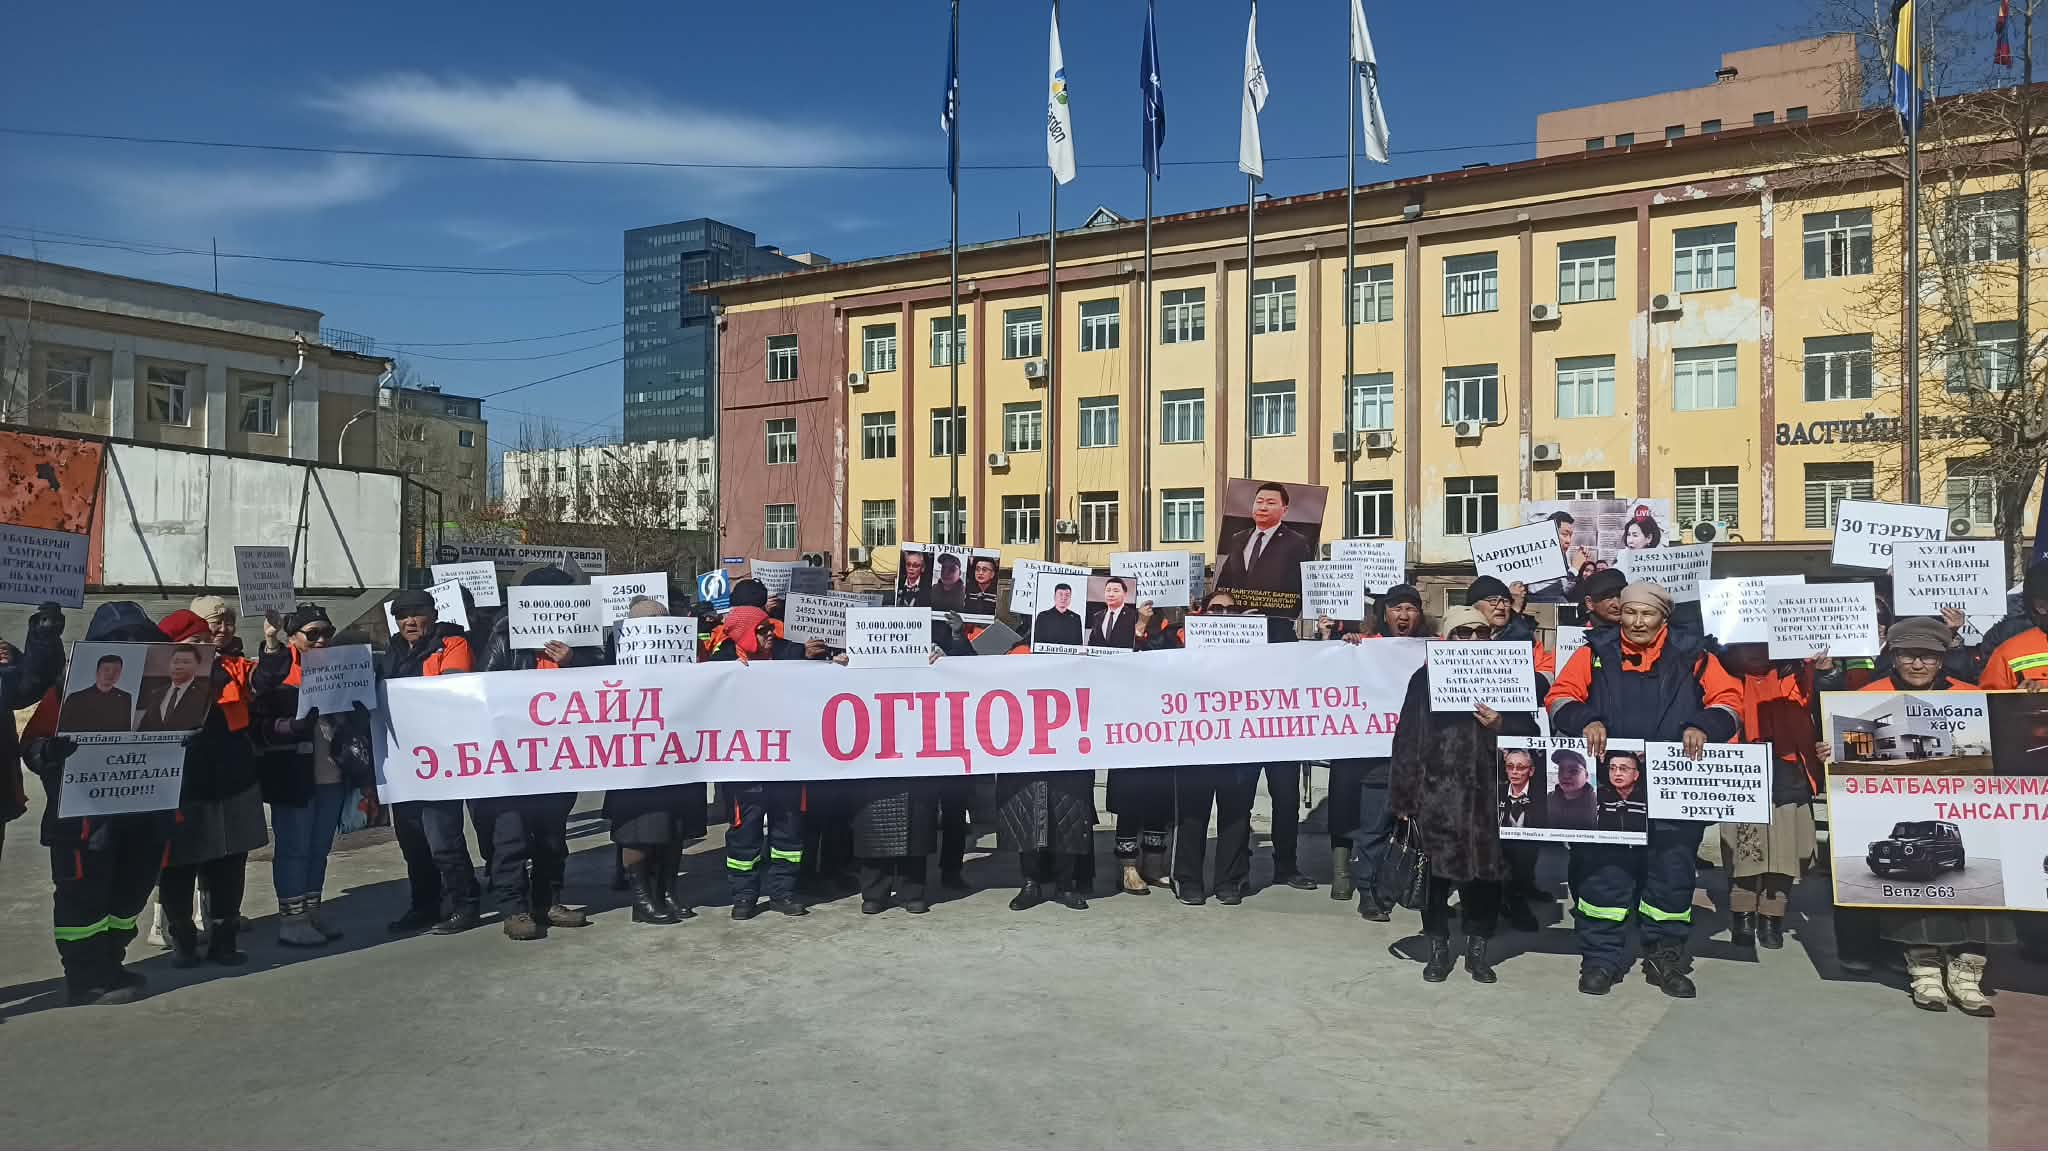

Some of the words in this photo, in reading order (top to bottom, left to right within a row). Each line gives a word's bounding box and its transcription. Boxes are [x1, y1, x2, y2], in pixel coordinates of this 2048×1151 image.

[1841, 518, 1863, 534] 30
[1866, 522, 1943, 541] ТЭРБУМ
[1476, 538, 1559, 563] ХАРИУЦЛАГА
[1868, 542, 1893, 556] ТӨ
[1496, 556, 1544, 573] ТООЦ!!!
[1905, 558, 1990, 569] ЭНХТАЙВАНЫ
[1917, 573, 1979, 583] БАТБАЯРТ
[612, 584, 646, 595] 24500
[518, 600, 591, 609] 30.000.000.000
[512, 626, 554, 635] ХААНА
[557, 624, 600, 634] БАЙНА
[666, 624, 693, 635] БУС
[855, 621, 922, 631] 30.000.000.000
[848, 645, 888, 655] ХААНА
[890, 644, 929, 654] БАЙНА
[1433, 648, 1469, 656] ХУЛГАЙ
[1471, 648, 1508, 656] ХИЙСЭН
[1509, 648, 1527, 656] БОЛ
[528, 679, 666, 731] САЙД
[1160, 691, 1190, 716] 30
[1194, 687, 1301, 714] ТЭРБУМ
[1306, 685, 1368, 711] ТӨЛ,
[1905, 704, 1983, 718] Шамбала
[820, 687, 1092, 774] ОГЦОР!
[1104, 717, 1233, 747] НООГДОЛ
[1239, 714, 1359, 740] АШИГАА
[1365, 711, 1400, 735] АВ
[1930, 720, 1966, 733] хаус
[1527, 737, 1546, 749] 3-н
[1550, 737, 1587, 749] УРВА
[106, 752, 147, 766] САЙД
[411, 729, 792, 781] Э.БАТАМГАЛАН
[1698, 748, 1744, 761] рвагч
[65, 767, 180, 784] Э.БАТАМГАЛАН
[1652, 759, 1693, 773] 24500
[1696, 762, 1762, 778] хувьцаа
[1653, 774, 1762, 789] эзэмшигчиди
[1845, 777, 1965, 795] Э.БАТБАЯР
[89, 784, 155, 799] ОГЦОР!!!
[1660, 788, 1678, 801] йг
[1882, 885, 1921, 897] Benz
[1925, 886, 1955, 898] G63
